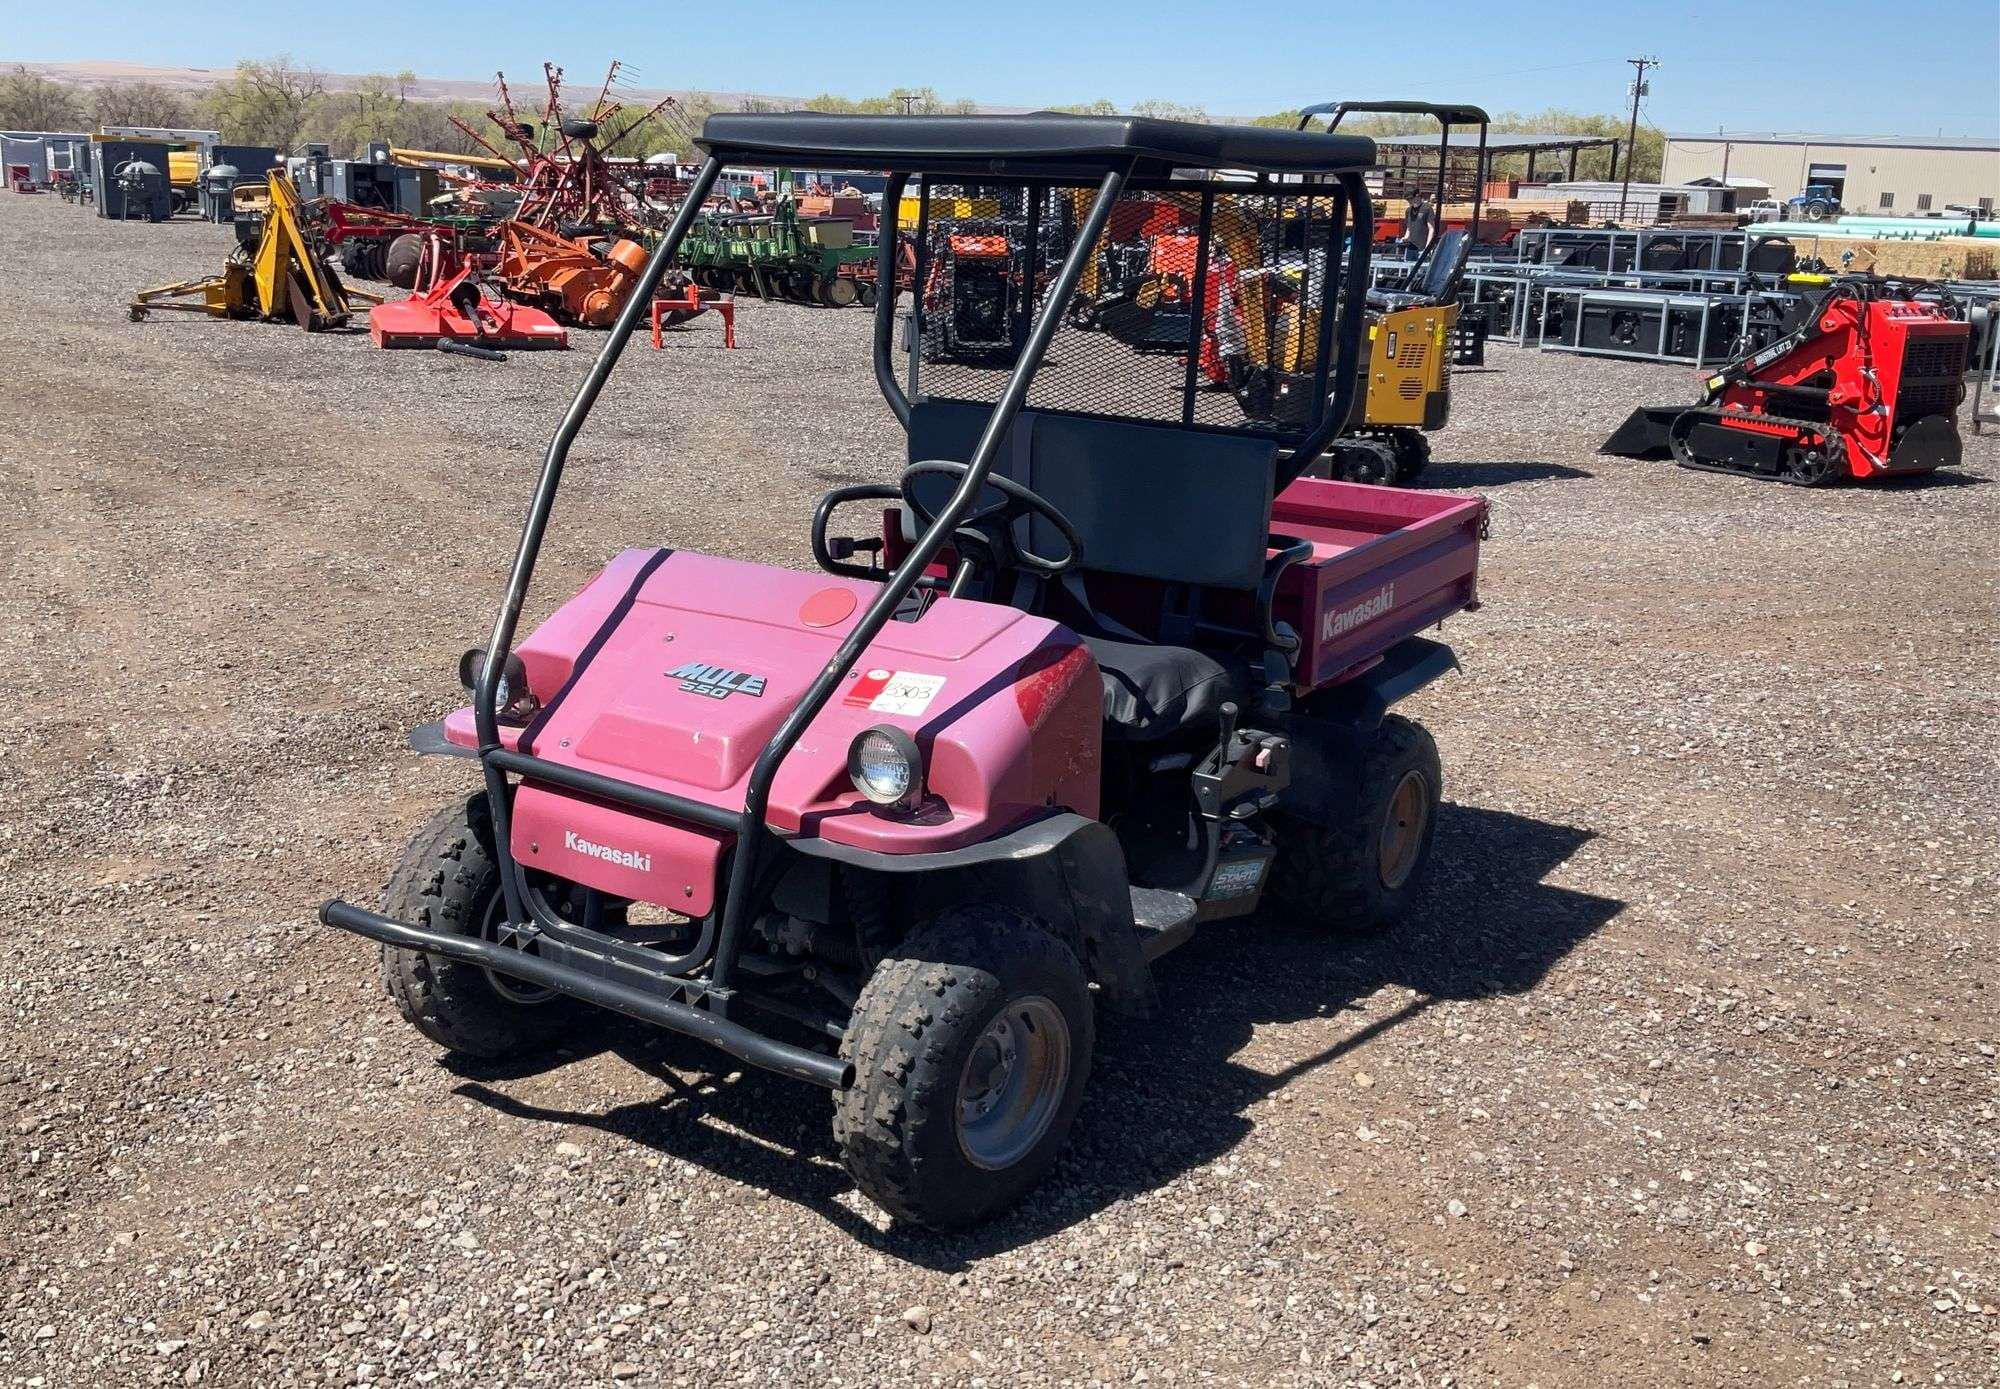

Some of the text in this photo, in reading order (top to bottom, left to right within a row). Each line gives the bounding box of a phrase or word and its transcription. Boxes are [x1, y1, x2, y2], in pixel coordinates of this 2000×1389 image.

[1322, 582, 1394, 640] Kawasaki
[664, 662, 766, 697] MULE
[678, 681, 729, 699] 550
[565, 830, 651, 872] Kawasaki
